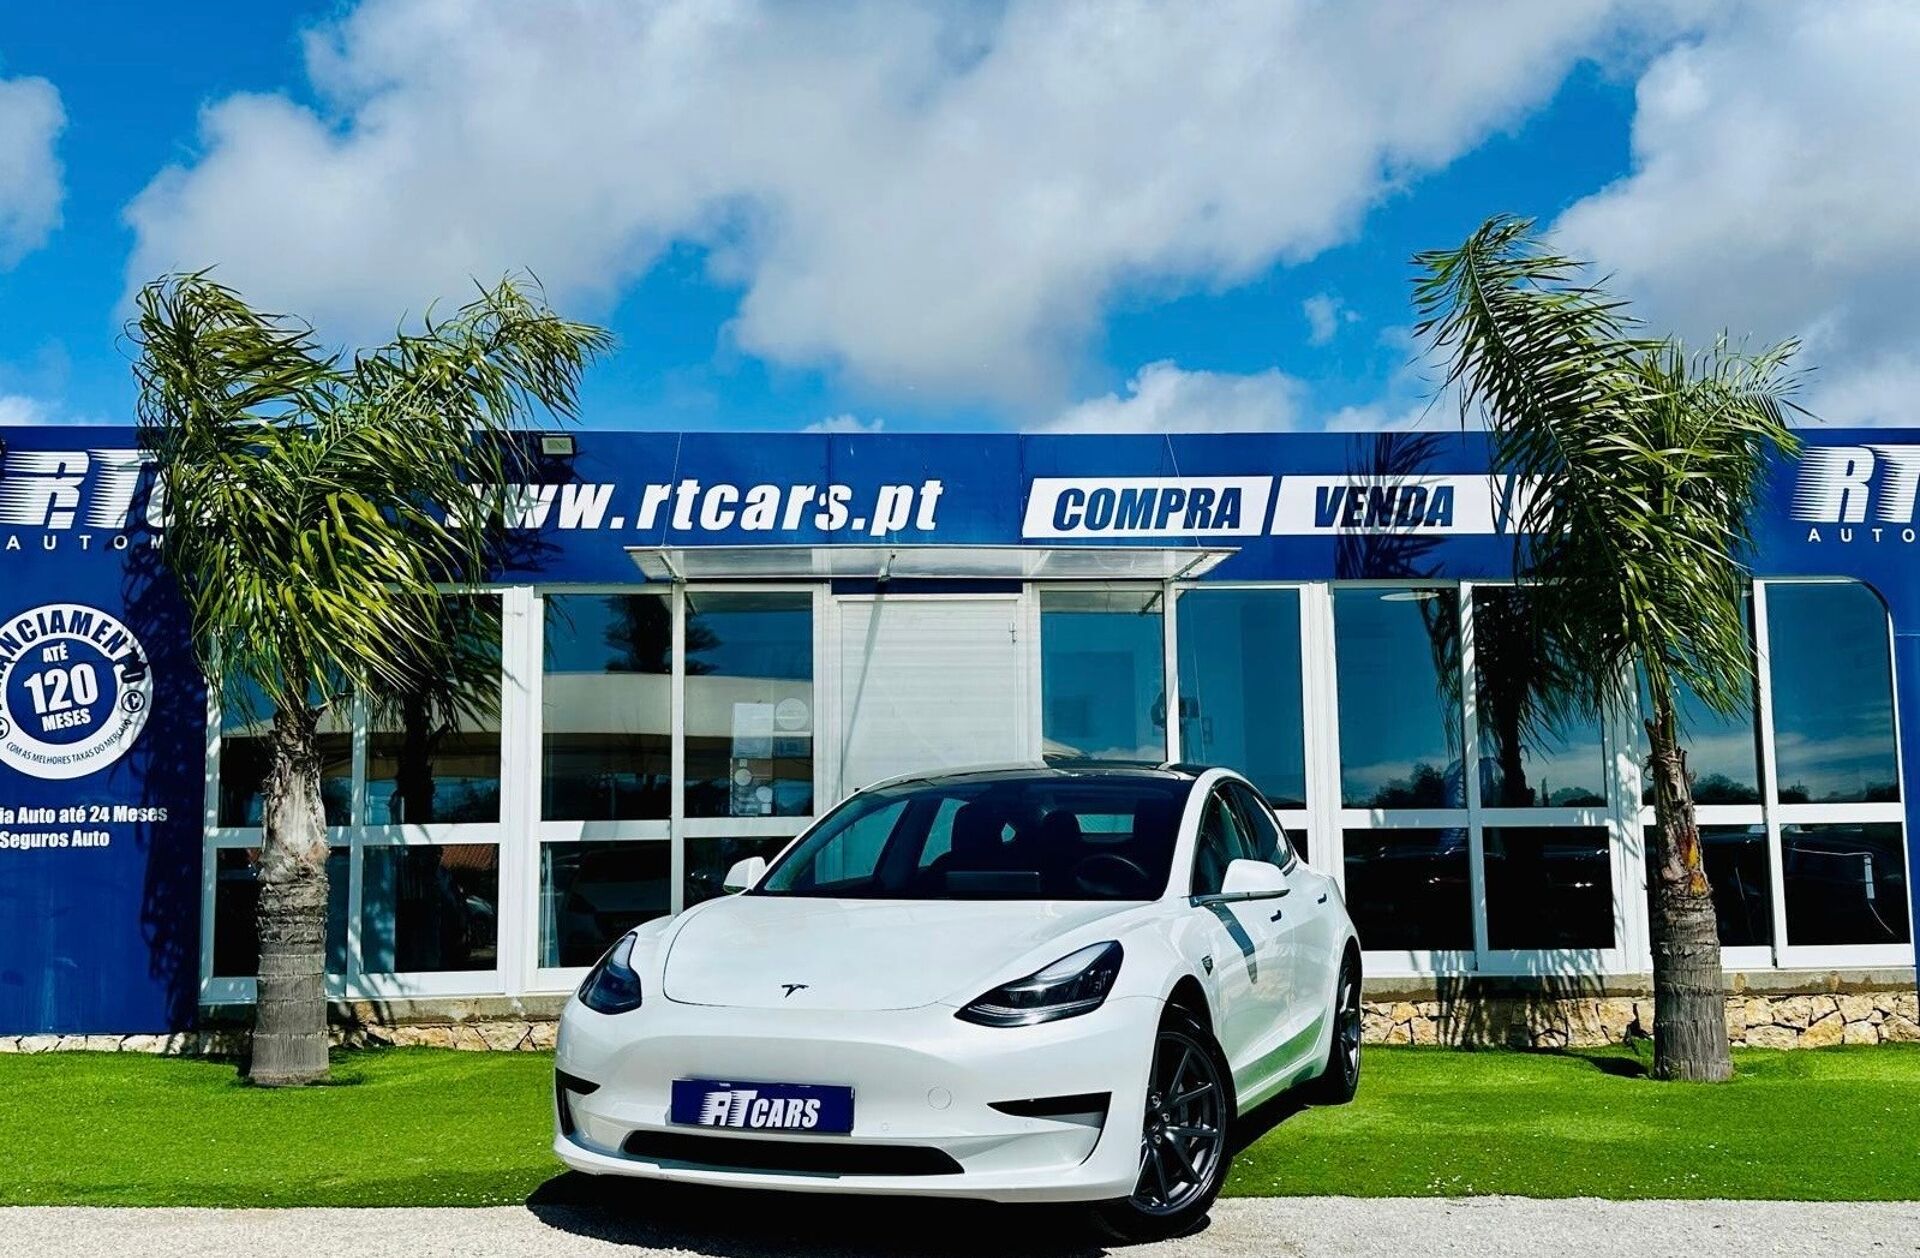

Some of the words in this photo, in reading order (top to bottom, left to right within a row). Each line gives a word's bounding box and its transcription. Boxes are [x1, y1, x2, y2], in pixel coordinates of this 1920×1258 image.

[444, 479, 943, 536] www.rtcars.pt
[1052, 487, 1242, 531] COMPRA
[1315, 485, 1454, 528] VENDA
[6, 535, 164, 550] AUTOM
[43, 641, 69, 663] ATÉ
[24, 663, 98, 715] 120
[42, 708, 91, 732] MESES
[17, 807, 56, 824] Auto
[58, 805, 87, 823] até
[89, 806, 110, 823] 24
[113, 805, 168, 823] Meses
[0, 831, 69, 850] Seguros
[71, 830, 110, 847] Auto
